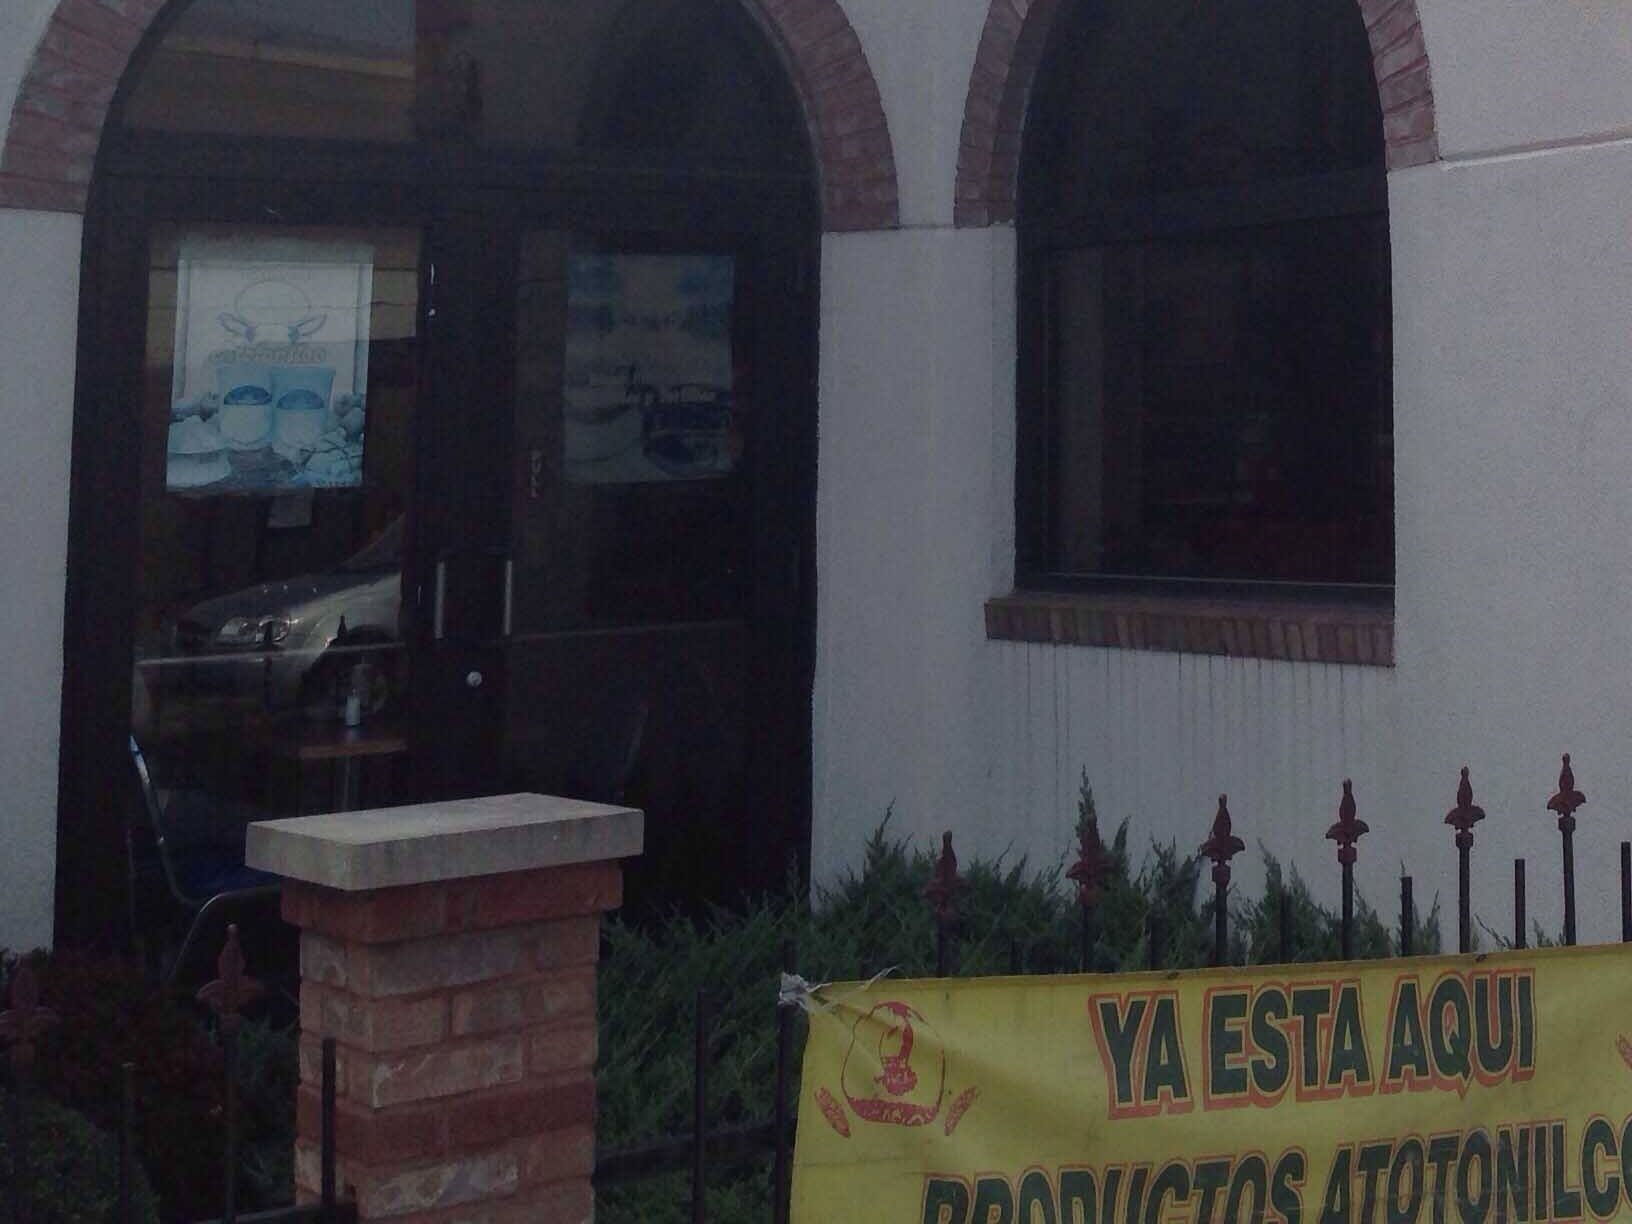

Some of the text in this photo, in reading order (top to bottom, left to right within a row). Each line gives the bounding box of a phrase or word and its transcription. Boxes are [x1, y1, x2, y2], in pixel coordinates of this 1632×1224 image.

[1091, 969, 1535, 1116] YA ESTA AQUI
